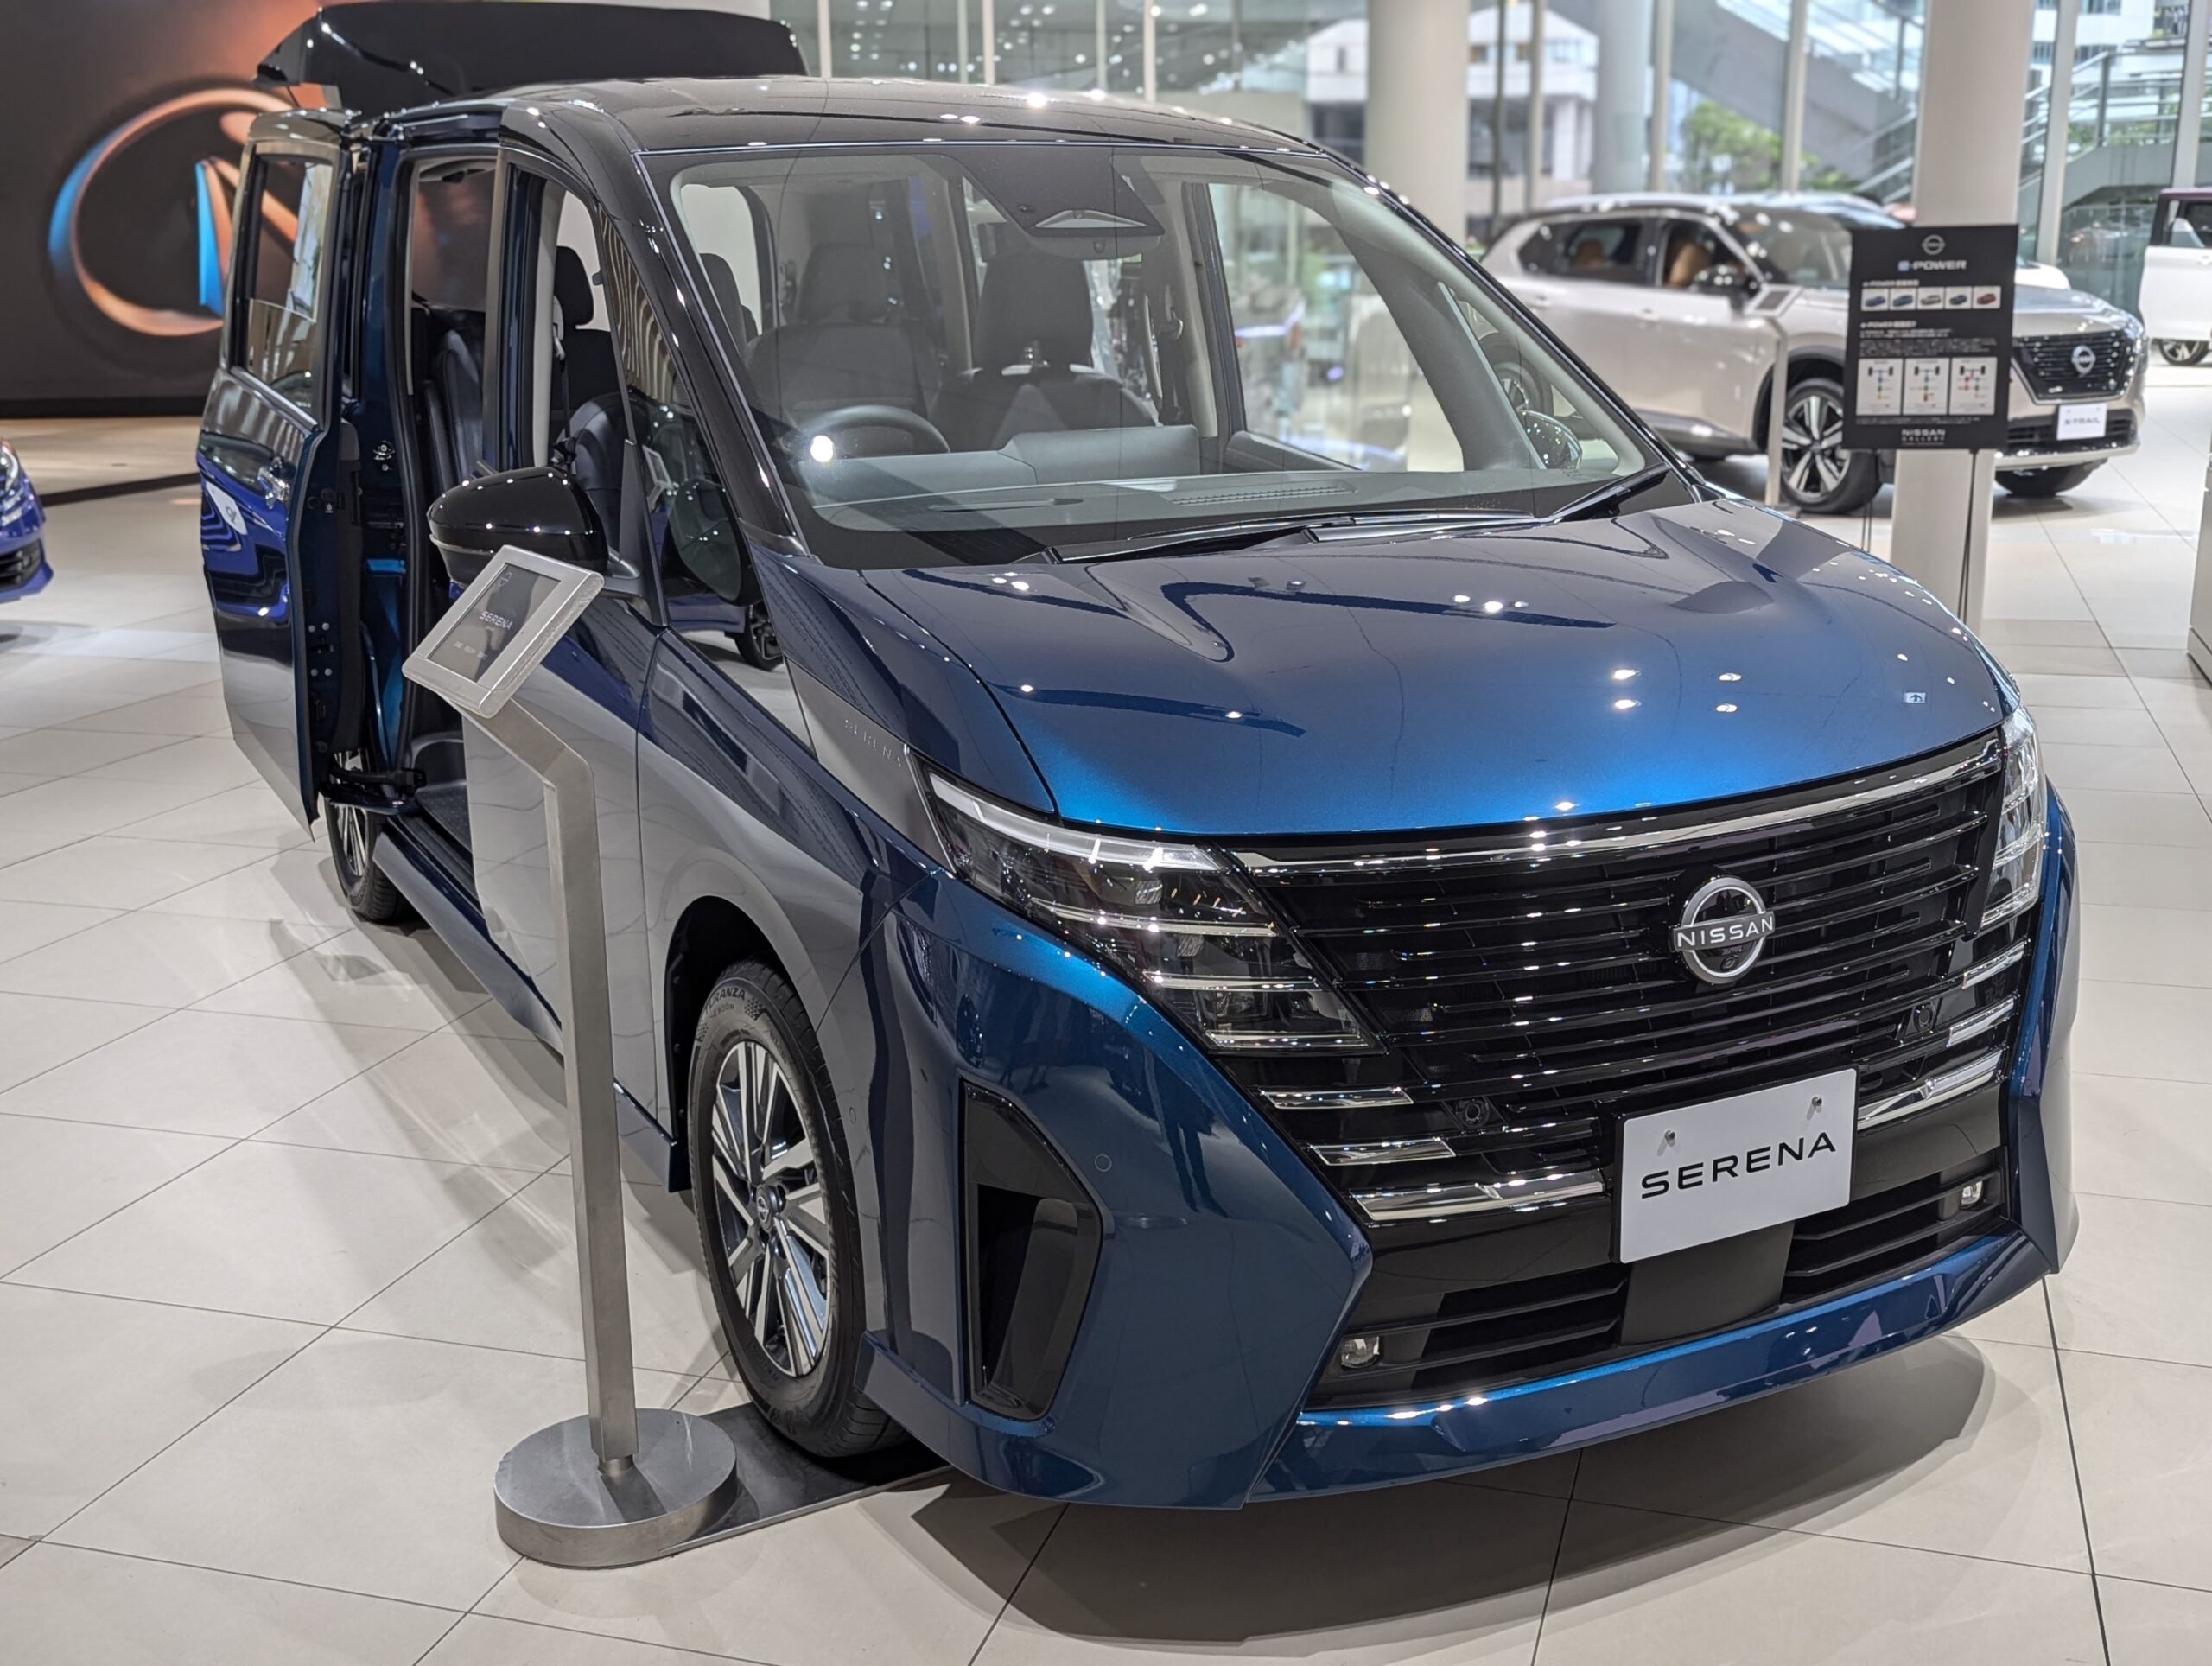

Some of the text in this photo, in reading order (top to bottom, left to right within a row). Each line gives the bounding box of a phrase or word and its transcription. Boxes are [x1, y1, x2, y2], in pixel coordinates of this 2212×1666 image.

[1898, 260, 1967, 272] -POWER
[479, 610, 514, 631] SERENA
[1677, 916, 1773, 948] NISSAN
[1642, 1132, 1836, 1199] SERENA
